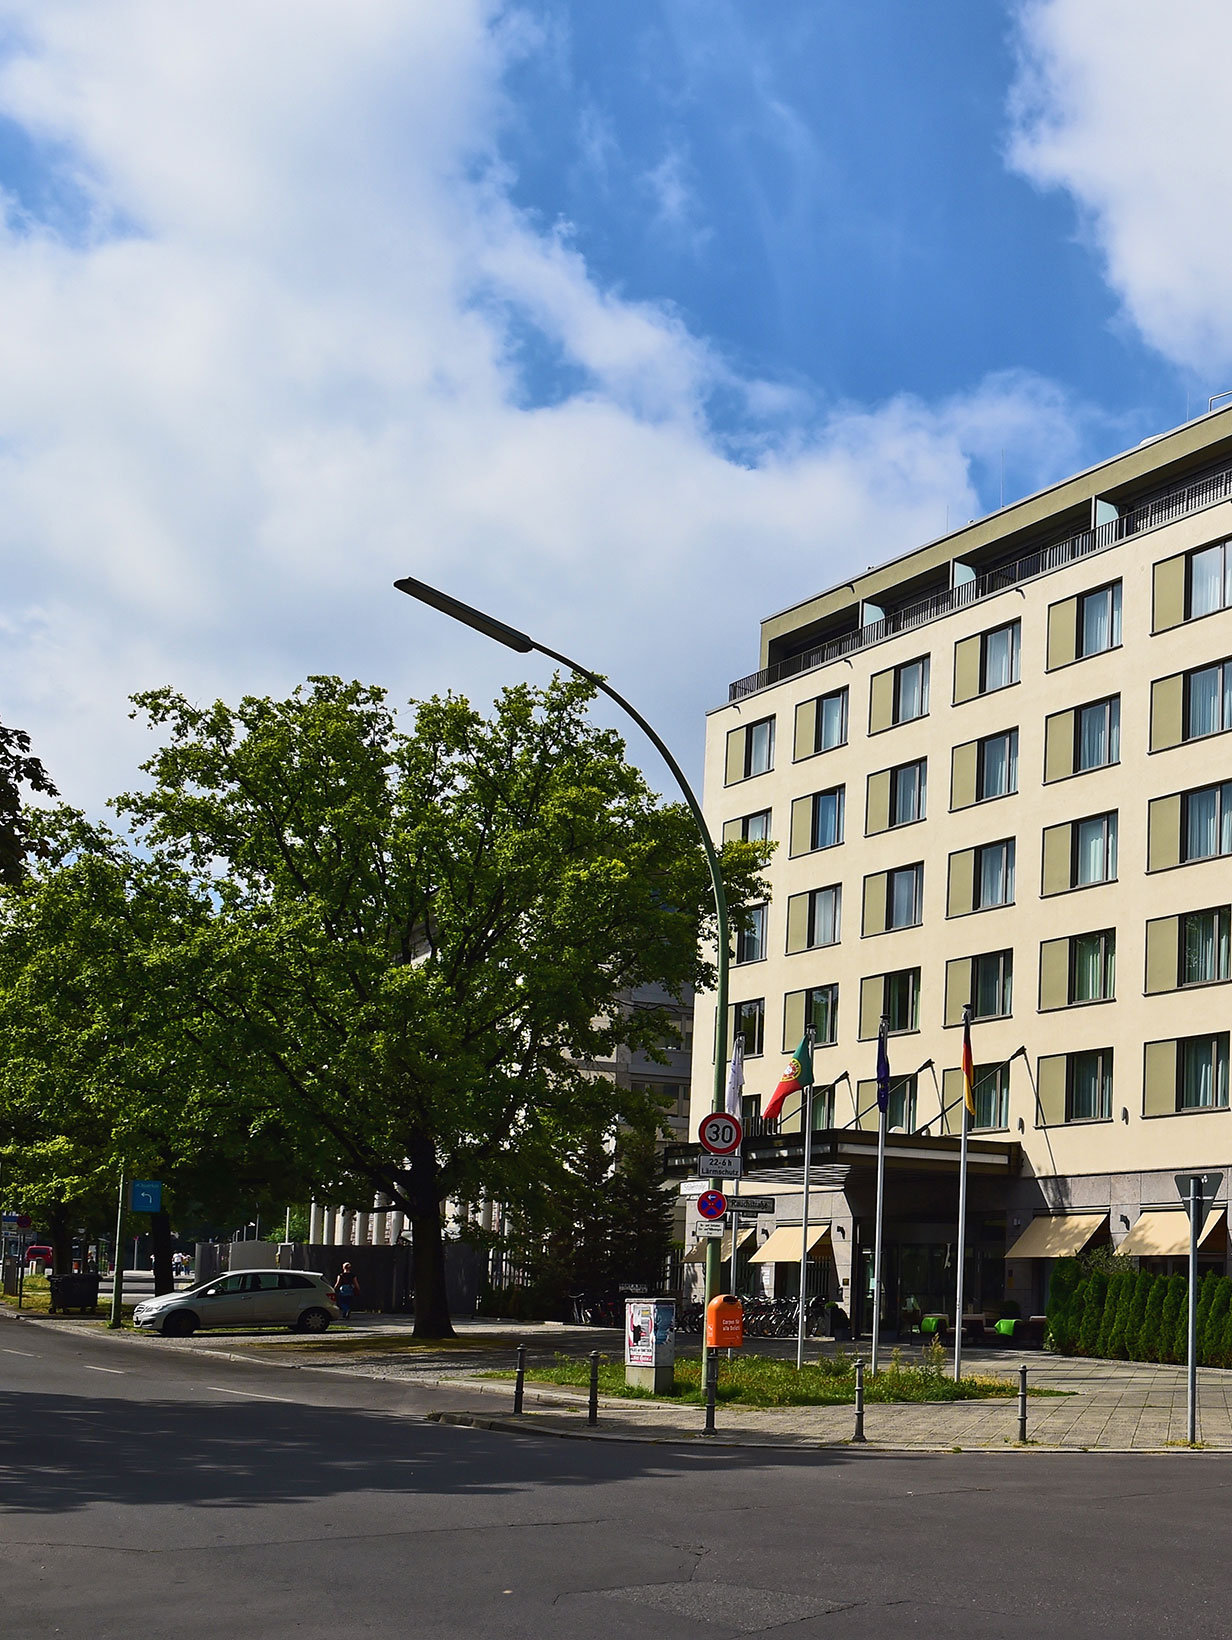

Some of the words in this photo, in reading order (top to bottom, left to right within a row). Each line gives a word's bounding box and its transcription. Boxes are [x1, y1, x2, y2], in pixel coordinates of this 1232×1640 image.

[708, 1123, 733, 1143] 30
[709, 1158, 727, 1167] 22-6
[701, 1167, 739, 1176] Lärmschutz
